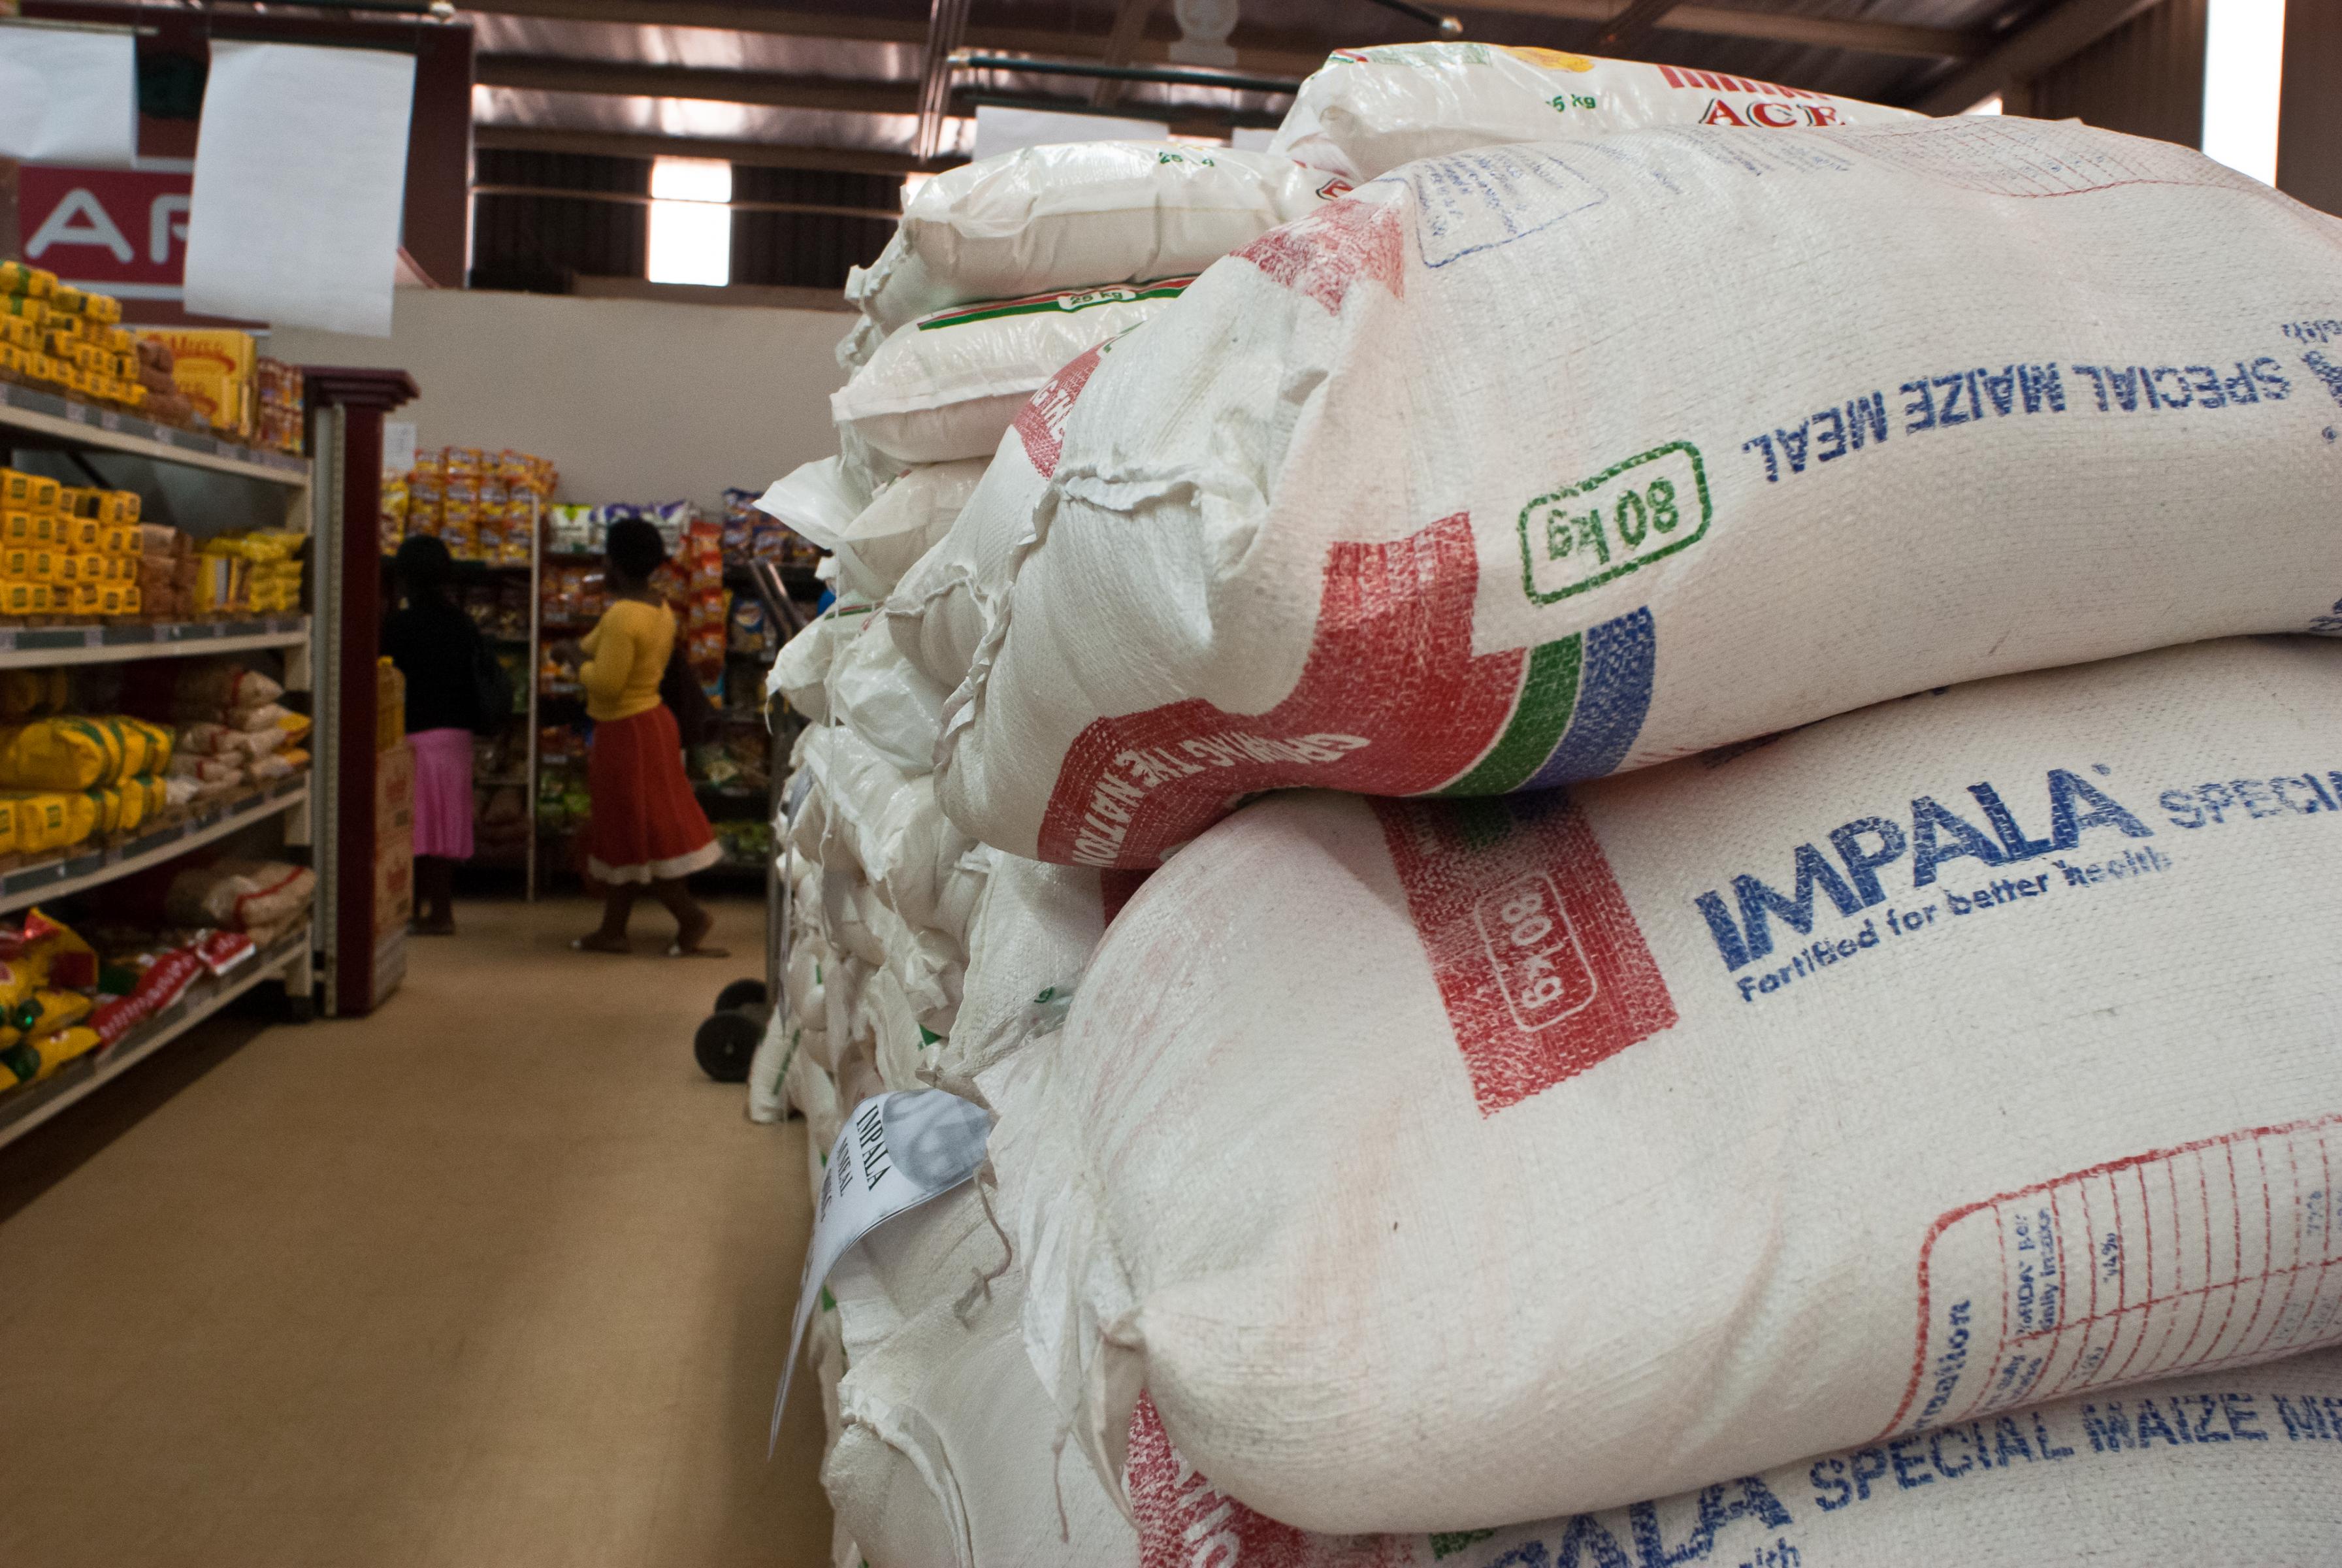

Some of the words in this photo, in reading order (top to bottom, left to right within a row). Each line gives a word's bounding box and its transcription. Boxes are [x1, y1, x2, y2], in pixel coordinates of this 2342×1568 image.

[1570, 94, 1596, 109] kg
[1899, 362, 2066, 436] MAIZE
[2072, 357, 2292, 412] SPECIAL
[1742, 390, 1888, 482] MEAL
[1546, 508, 1610, 565] kg
[1614, 476, 1679, 547] 80
[1114, 747, 1207, 788] THE
[1071, 766, 1146, 868] NATION
[1694, 767, 2155, 973] IMPALA
[1502, 892, 1552, 947] 80
[1886, 904, 1938, 936] for
[1940, 874, 2049, 915] better
[1522, 942, 1565, 1009] kg
[856, 1103, 892, 1192] IMPALA
[1809, 1411, 2075, 1512] SPECIAL
[2081, 1393, 2269, 1452] MAIZE
